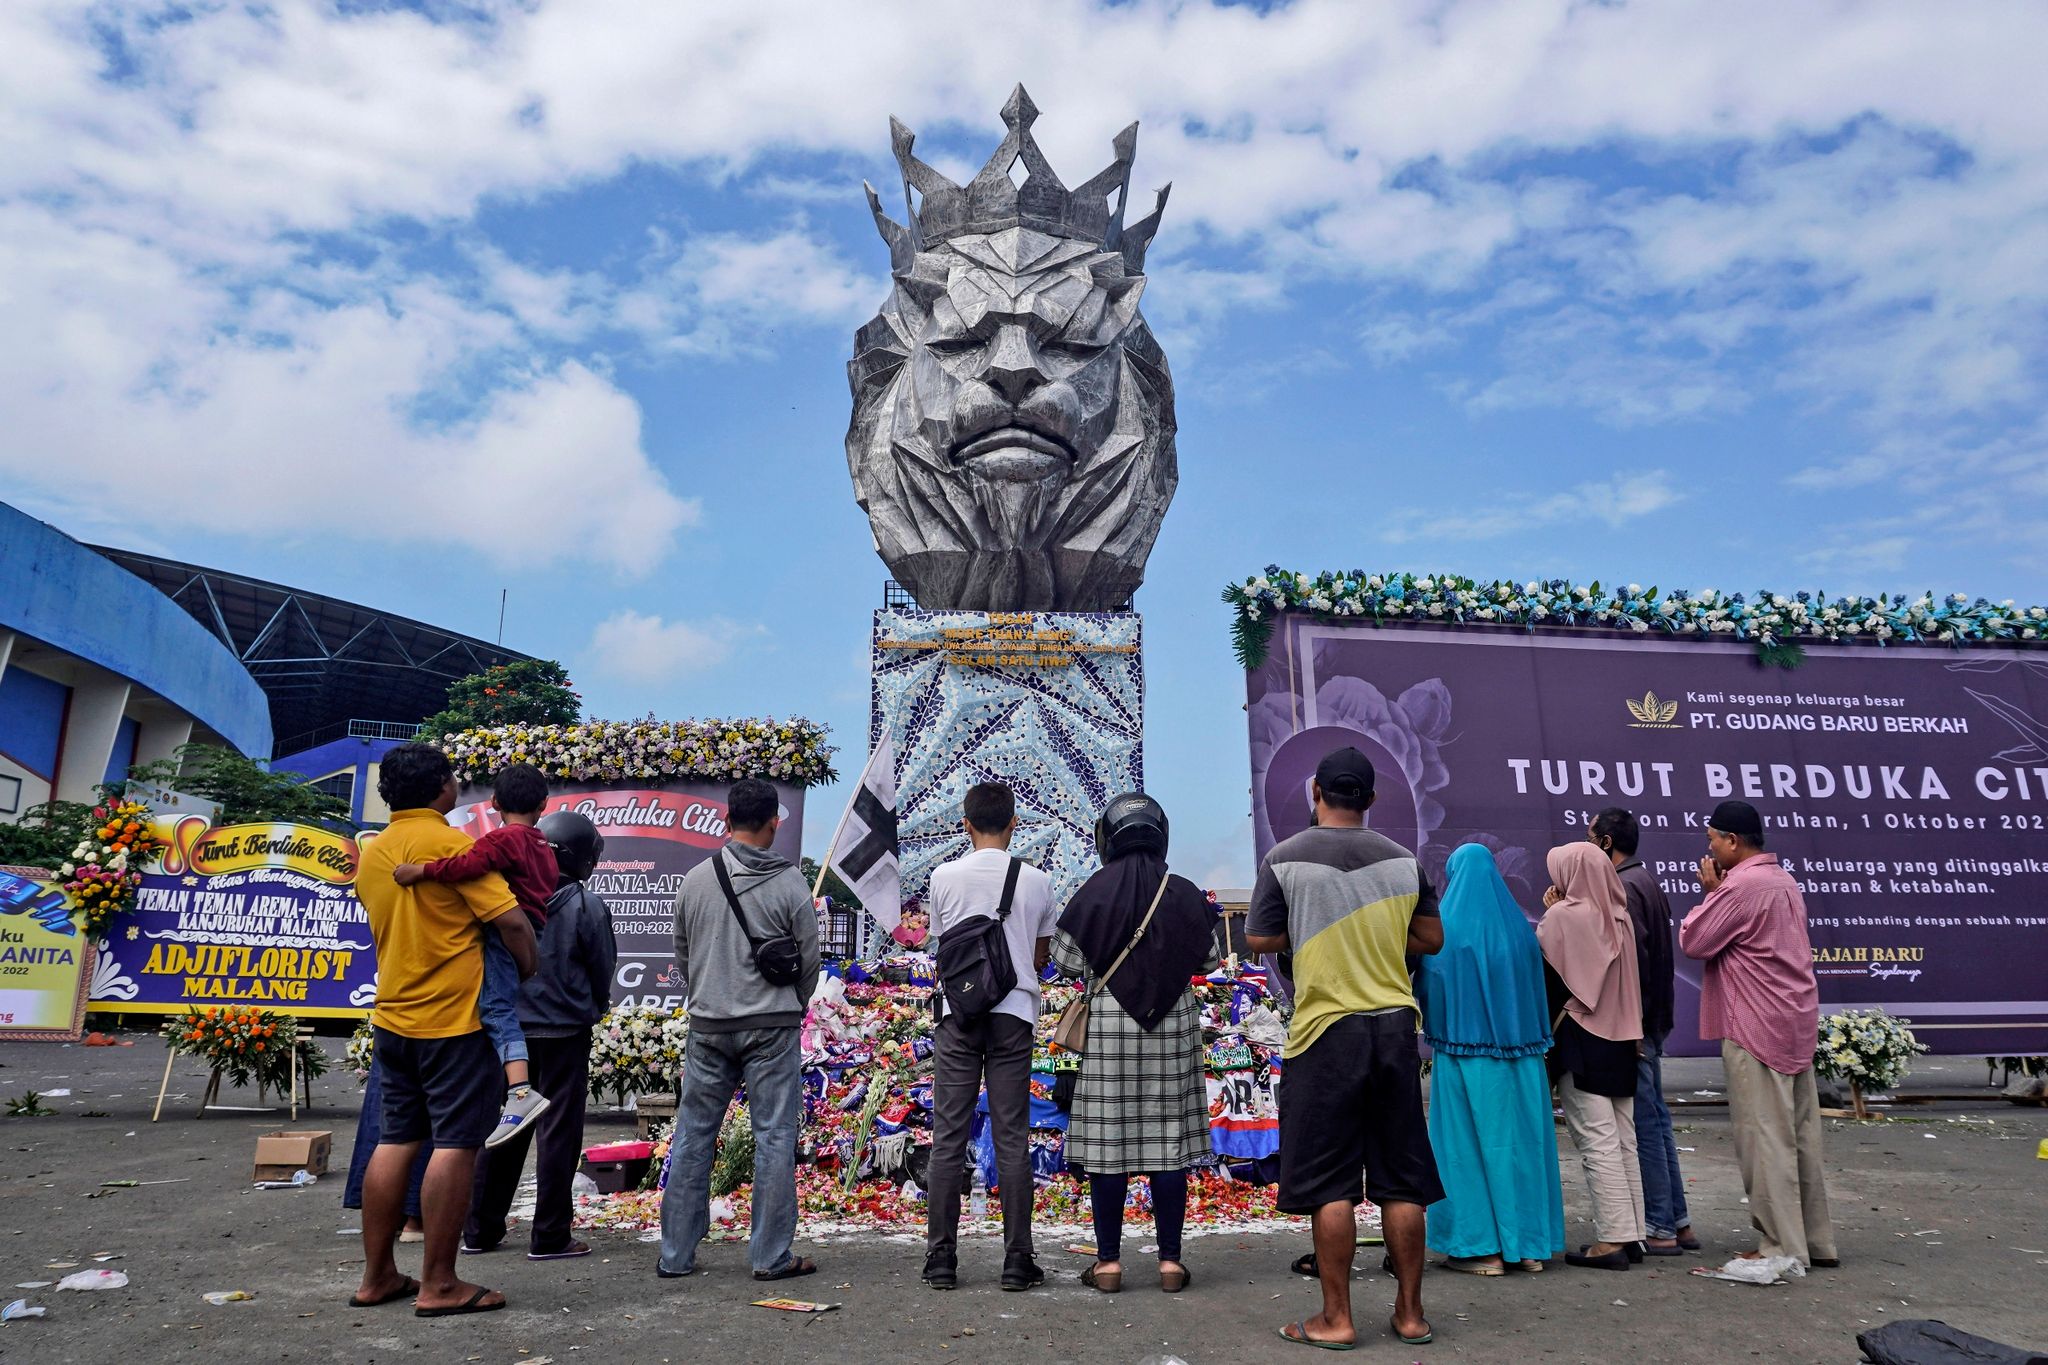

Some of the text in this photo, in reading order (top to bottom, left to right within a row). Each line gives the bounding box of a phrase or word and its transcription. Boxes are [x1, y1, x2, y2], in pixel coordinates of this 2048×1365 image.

[987, 628, 1023, 640] THAN
[1000, 655, 1033, 666] SATU
[1686, 691, 1905, 708] Kami segenap keluarga besar
[1690, 712, 1968, 734] PT. GUDANG BARU BERKAH
[1507, 758, 1674, 797] TURUT
[1704, 763, 1951, 799] BERDUKA
[573, 798, 728, 837] Berduka Cita
[1564, 809, 2048, 830] Ston Karuhan, 1 Oktober 202
[198, 836, 240, 863] Turut
[244, 834, 314, 859] Berduka
[1655, 859, 1699, 875] para
[1782, 858, 1796, 872] &
[1803, 857, 1887, 876] keluarga
[1893, 861, 1938, 876] yang
[206, 868, 343, 900] Atas Meninggalnya
[1660, 878, 1996, 894] dibe abaran & ketabahan.
[136, 888, 190, 913] TEMAN
[193, 891, 246, 916] TEMAN
[177, 912, 339, 938] KANJURUHAN MALANG
[612, 921, 674, 935] 01-10-202
[1808, 916, 2048, 928] yang sebanding dengan sebuah nyaw
[141, 943, 353, 981] ADJIFLORIST
[1871, 947, 1924, 962] BARU
[2, 966, 29, 975] 2022
[1869, 962, 1922, 982] Segalanya
[181, 977, 308, 1001] MALANG
